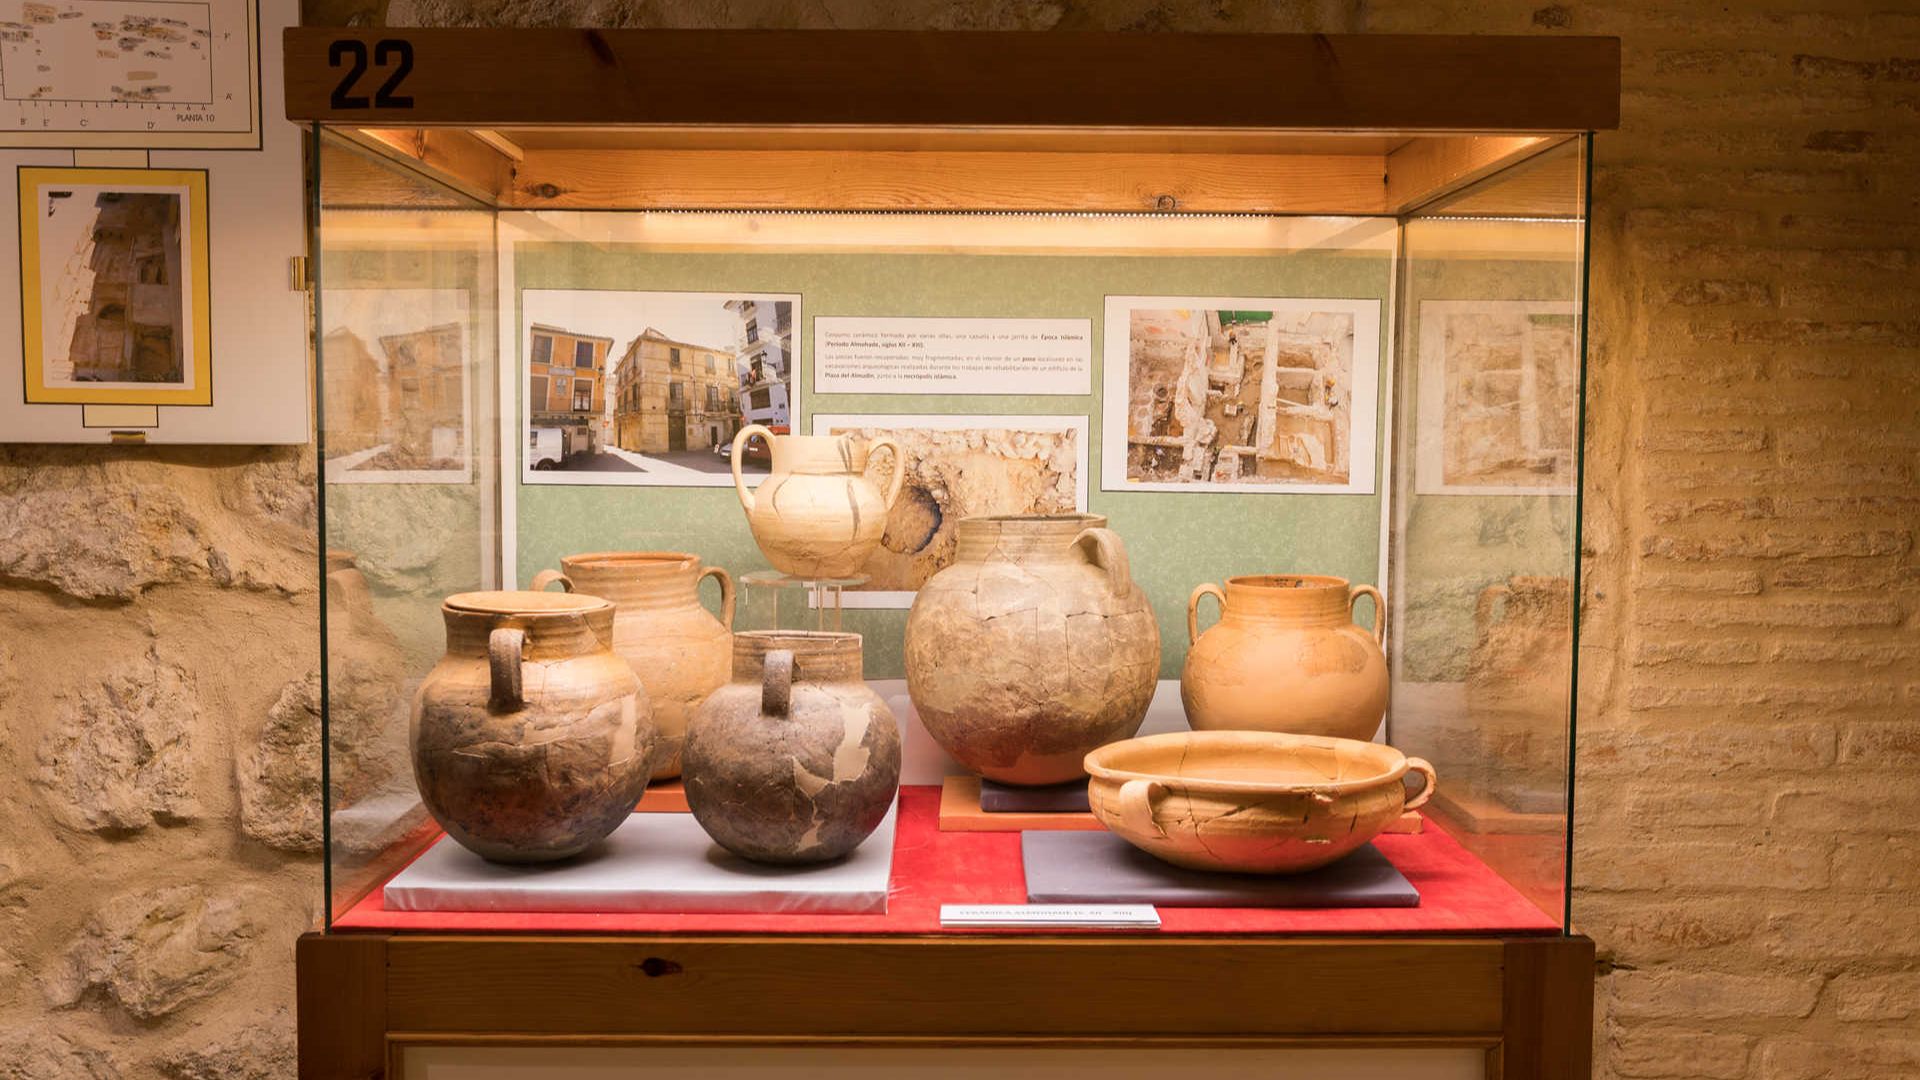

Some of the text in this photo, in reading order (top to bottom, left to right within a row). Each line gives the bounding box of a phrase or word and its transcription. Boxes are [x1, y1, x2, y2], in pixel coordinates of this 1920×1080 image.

[329, 39, 414, 110] 22
[176, 113, 215, 123] PLANTA 10
